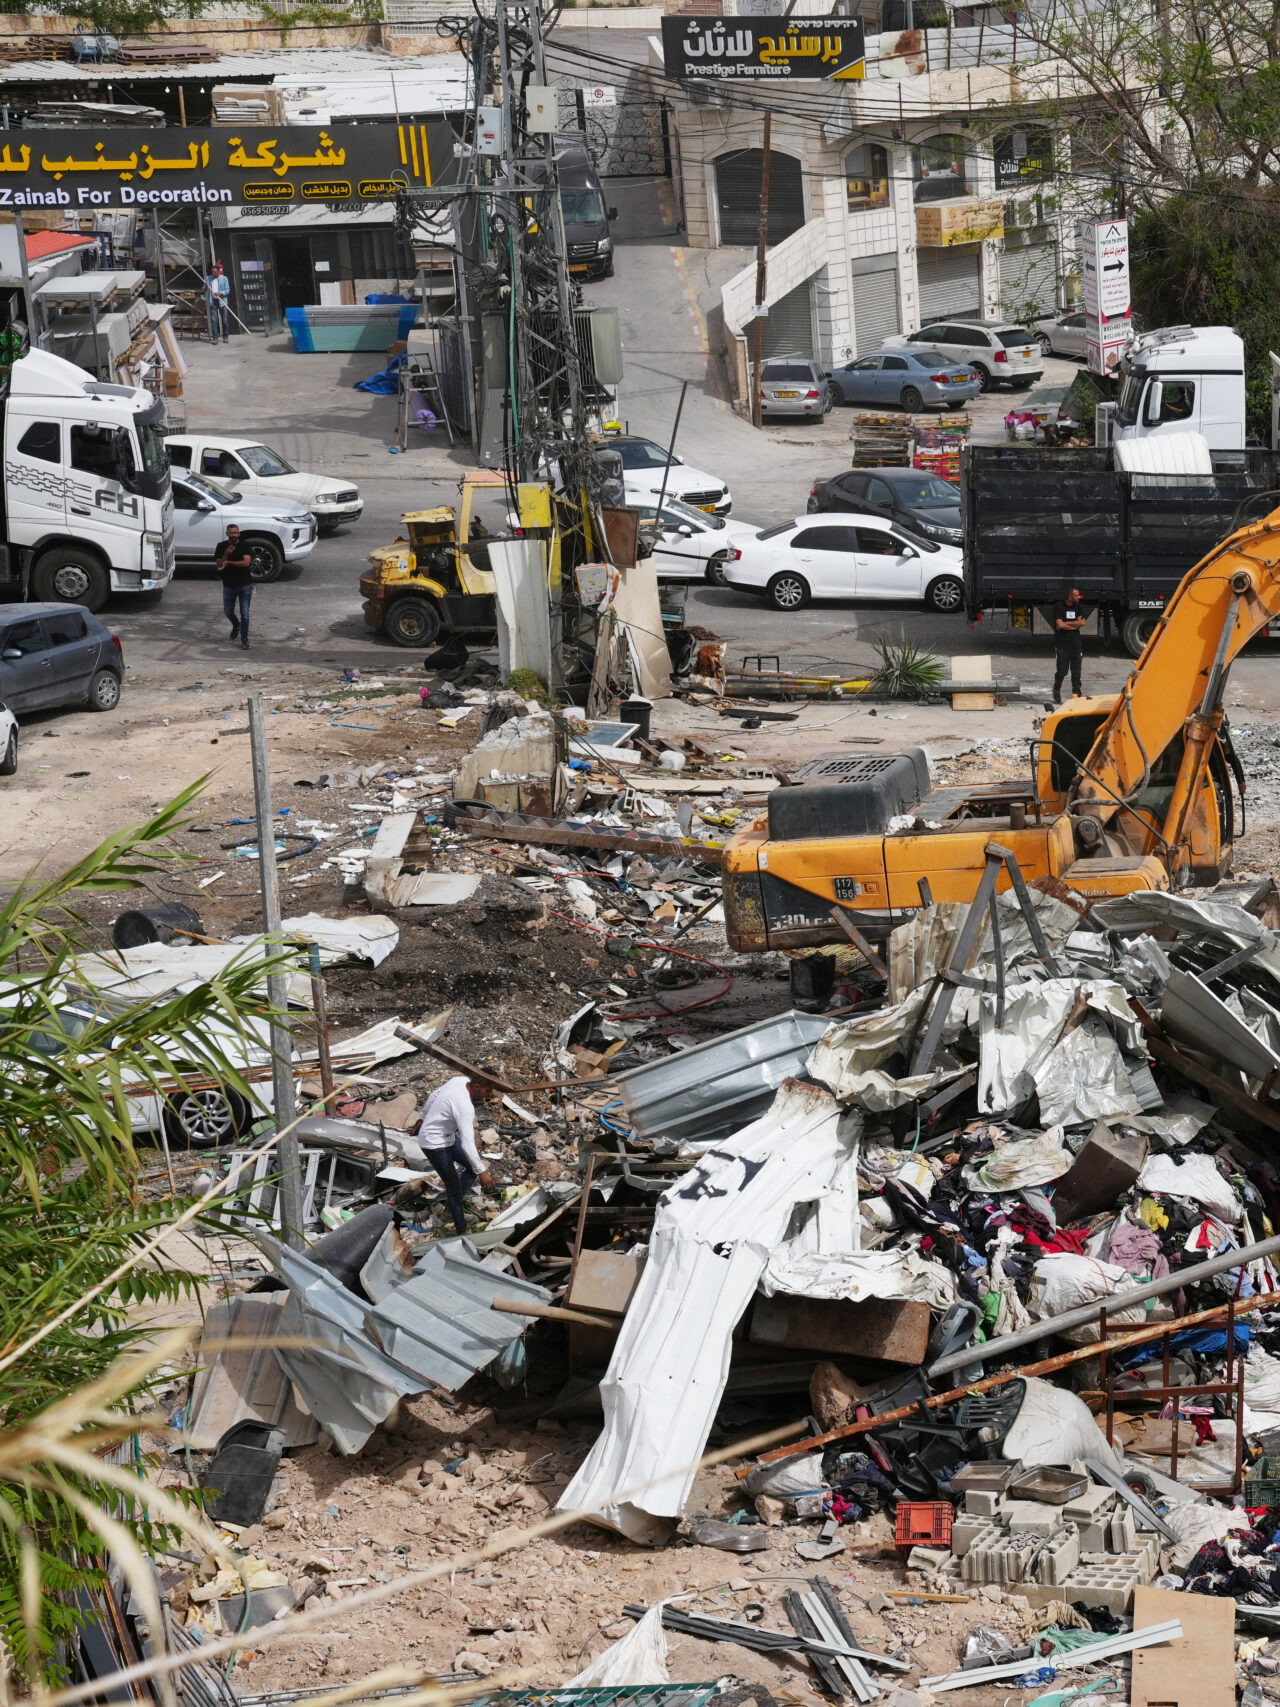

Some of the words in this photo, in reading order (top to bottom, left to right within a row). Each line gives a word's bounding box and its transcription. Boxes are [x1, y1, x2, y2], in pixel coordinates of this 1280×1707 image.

[758, 27, 842, 64] برستيج
[685, 63, 735, 77] Prestige
[737, 63, 791, 75] Furniture
[41, 139, 210, 182] الزينب
[228, 131, 346, 177] شركة
[0, 187, 71, 205] Zainab
[77, 187, 112, 204] For
[120, 181, 233, 203] Decoration
[95, 489, 138, 517] FH
[836, 878, 852, 888] 117
[837, 889, 854, 899] 156
